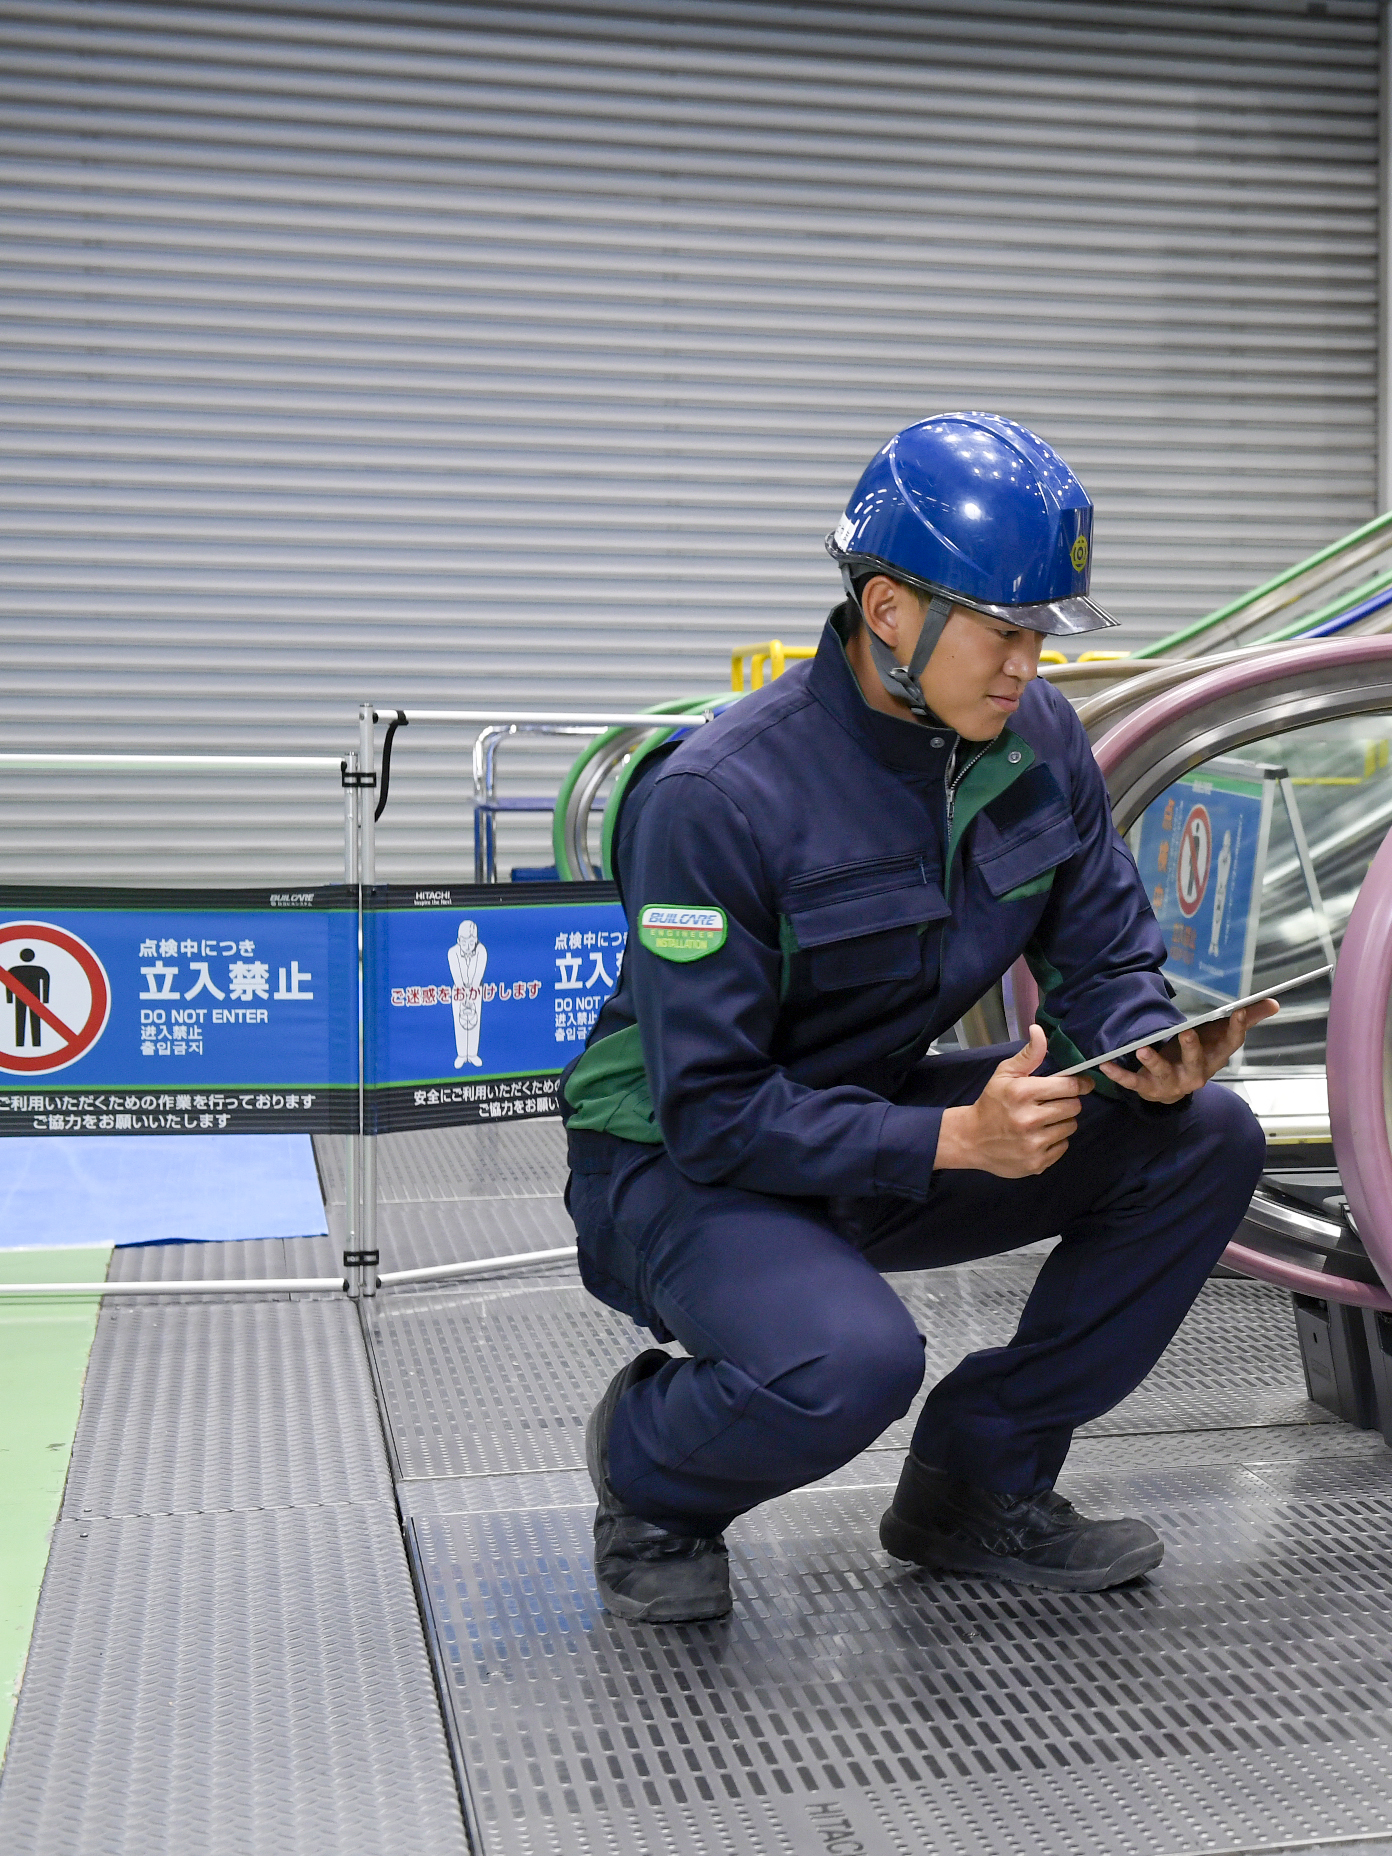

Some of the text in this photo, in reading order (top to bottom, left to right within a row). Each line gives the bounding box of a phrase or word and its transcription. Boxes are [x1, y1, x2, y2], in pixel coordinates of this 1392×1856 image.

[415, 890, 451, 900] HITACHI
[648, 912, 717, 926] BUILCARE
[650, 929, 714, 938] ENGINEER
[139, 938, 255, 958] 点検中につき
[656, 937, 708, 950] INSTALLATION
[555, 950, 625, 990] 立入
[139, 960, 314, 1001] 立入禁止
[391, 980, 541, 1006] ご迷惑をおかけします
[555, 997, 573, 1012] DO
[576, 996, 601, 1011] NOT
[140, 1009, 269, 1024] DO NOT ENTER
[555, 1026, 593, 1042] 출입금
[140, 1041, 203, 1055] 출입금지
[0, 1094, 316, 1111] ご利用いただくための作業を行っております
[33, 1113, 231, 1130] ご協力をお願いいたします
[804, 1801, 869, 1856] HITAC
